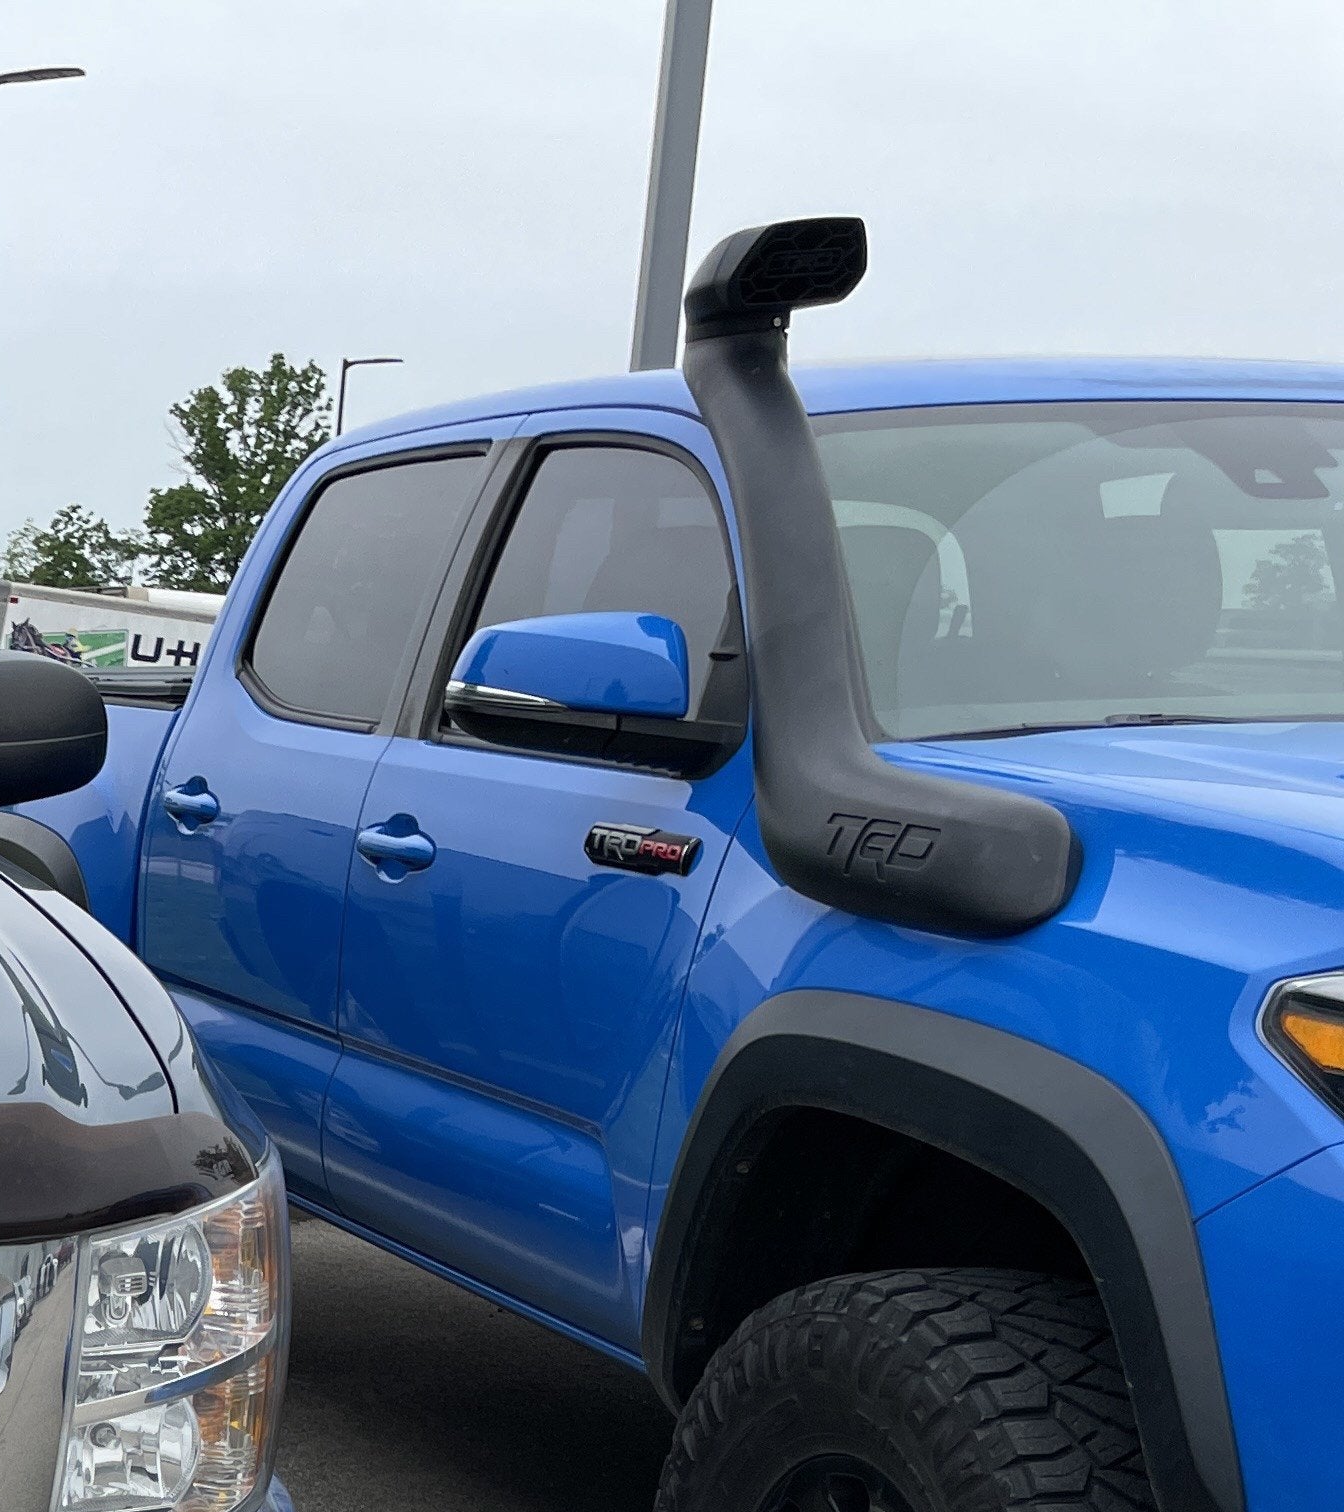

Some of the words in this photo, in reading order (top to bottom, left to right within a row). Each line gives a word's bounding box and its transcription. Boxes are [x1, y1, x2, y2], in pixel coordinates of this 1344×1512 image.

[592, 827, 642, 860] TRD
[639, 839, 682, 861] PRO
[827, 812, 942, 881] TRD
